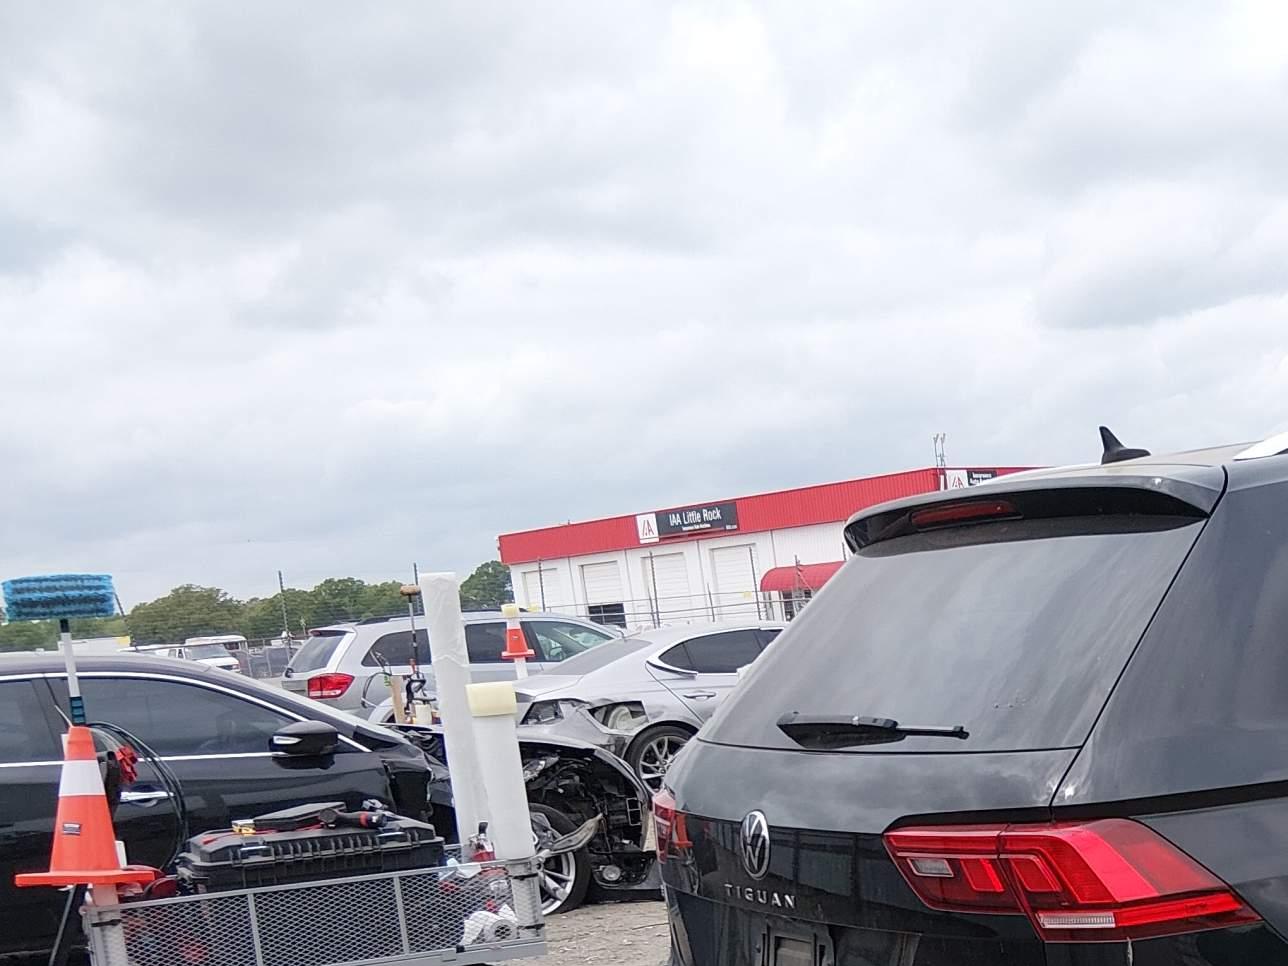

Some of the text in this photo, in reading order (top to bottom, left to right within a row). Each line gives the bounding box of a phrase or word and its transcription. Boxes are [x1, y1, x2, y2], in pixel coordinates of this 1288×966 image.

[669, 507, 722, 526] IAA Little Rock
[723, 883, 796, 909] TIGUAN
